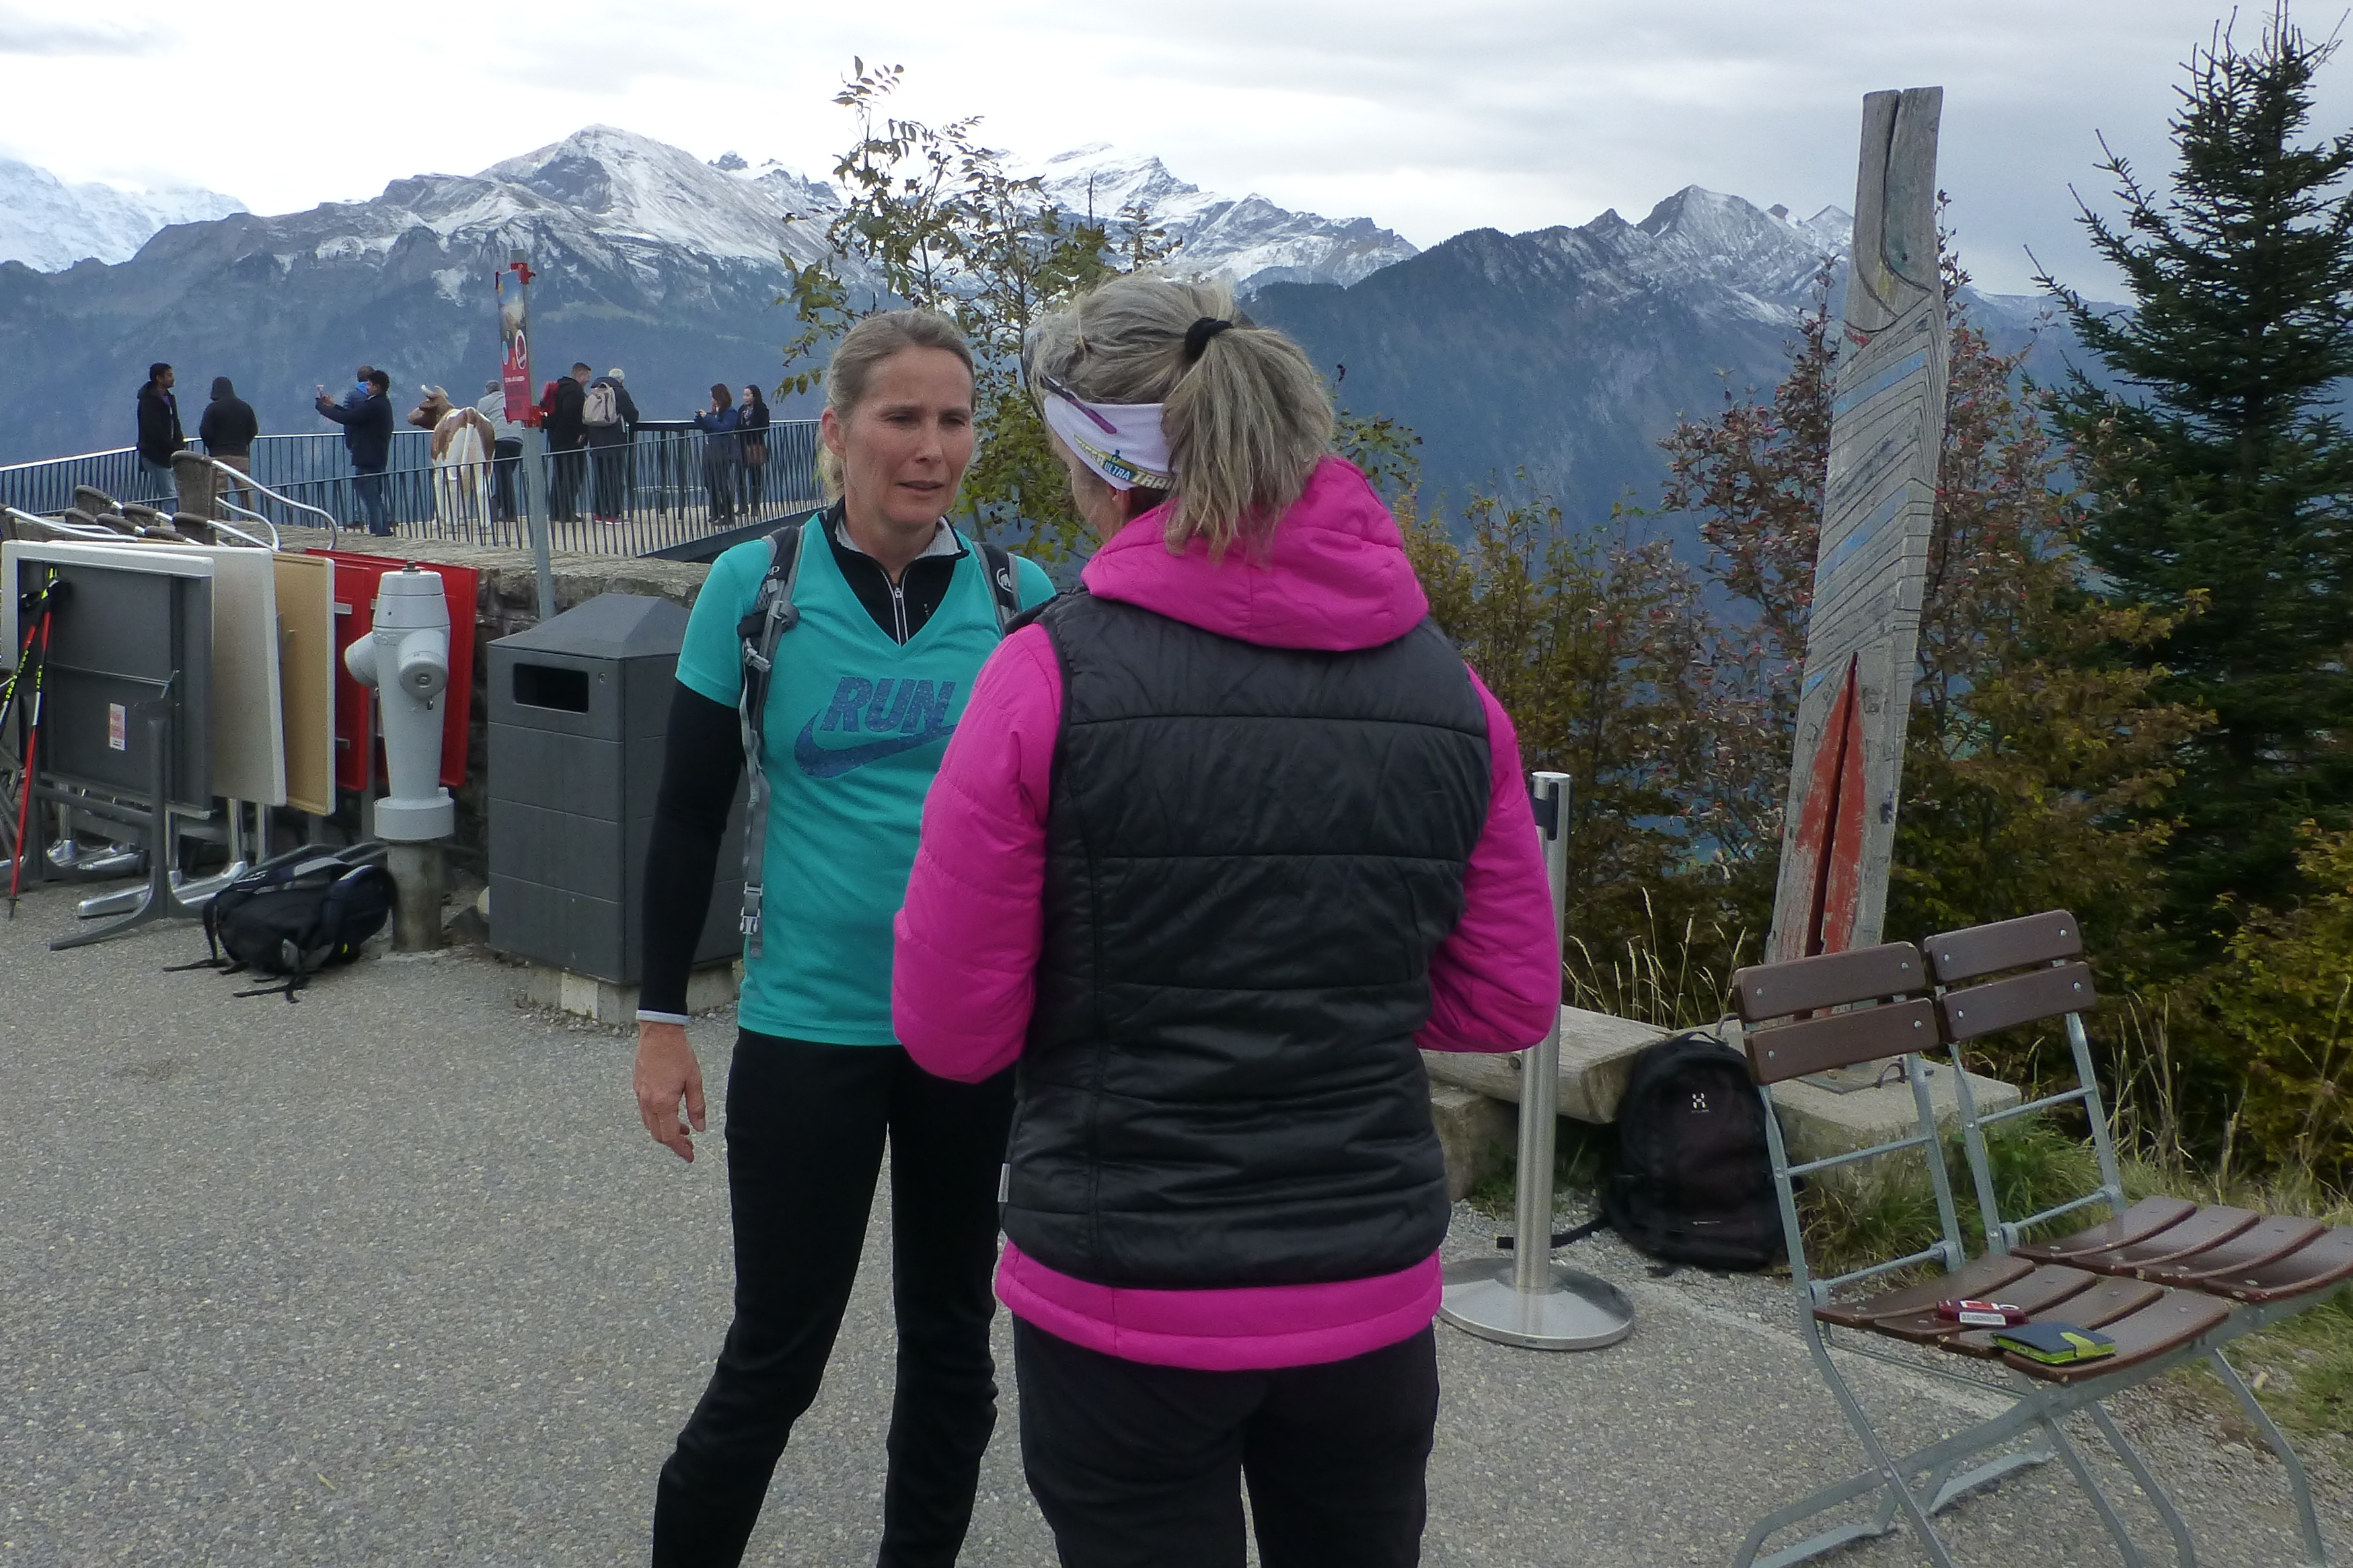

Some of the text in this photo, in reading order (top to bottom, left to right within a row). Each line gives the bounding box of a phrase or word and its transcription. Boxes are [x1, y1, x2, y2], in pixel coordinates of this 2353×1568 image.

[1104, 461, 1131, 481] ULTRA
[1132, 470, 1172, 491] TRAI
[820, 676, 957, 734] RUN
